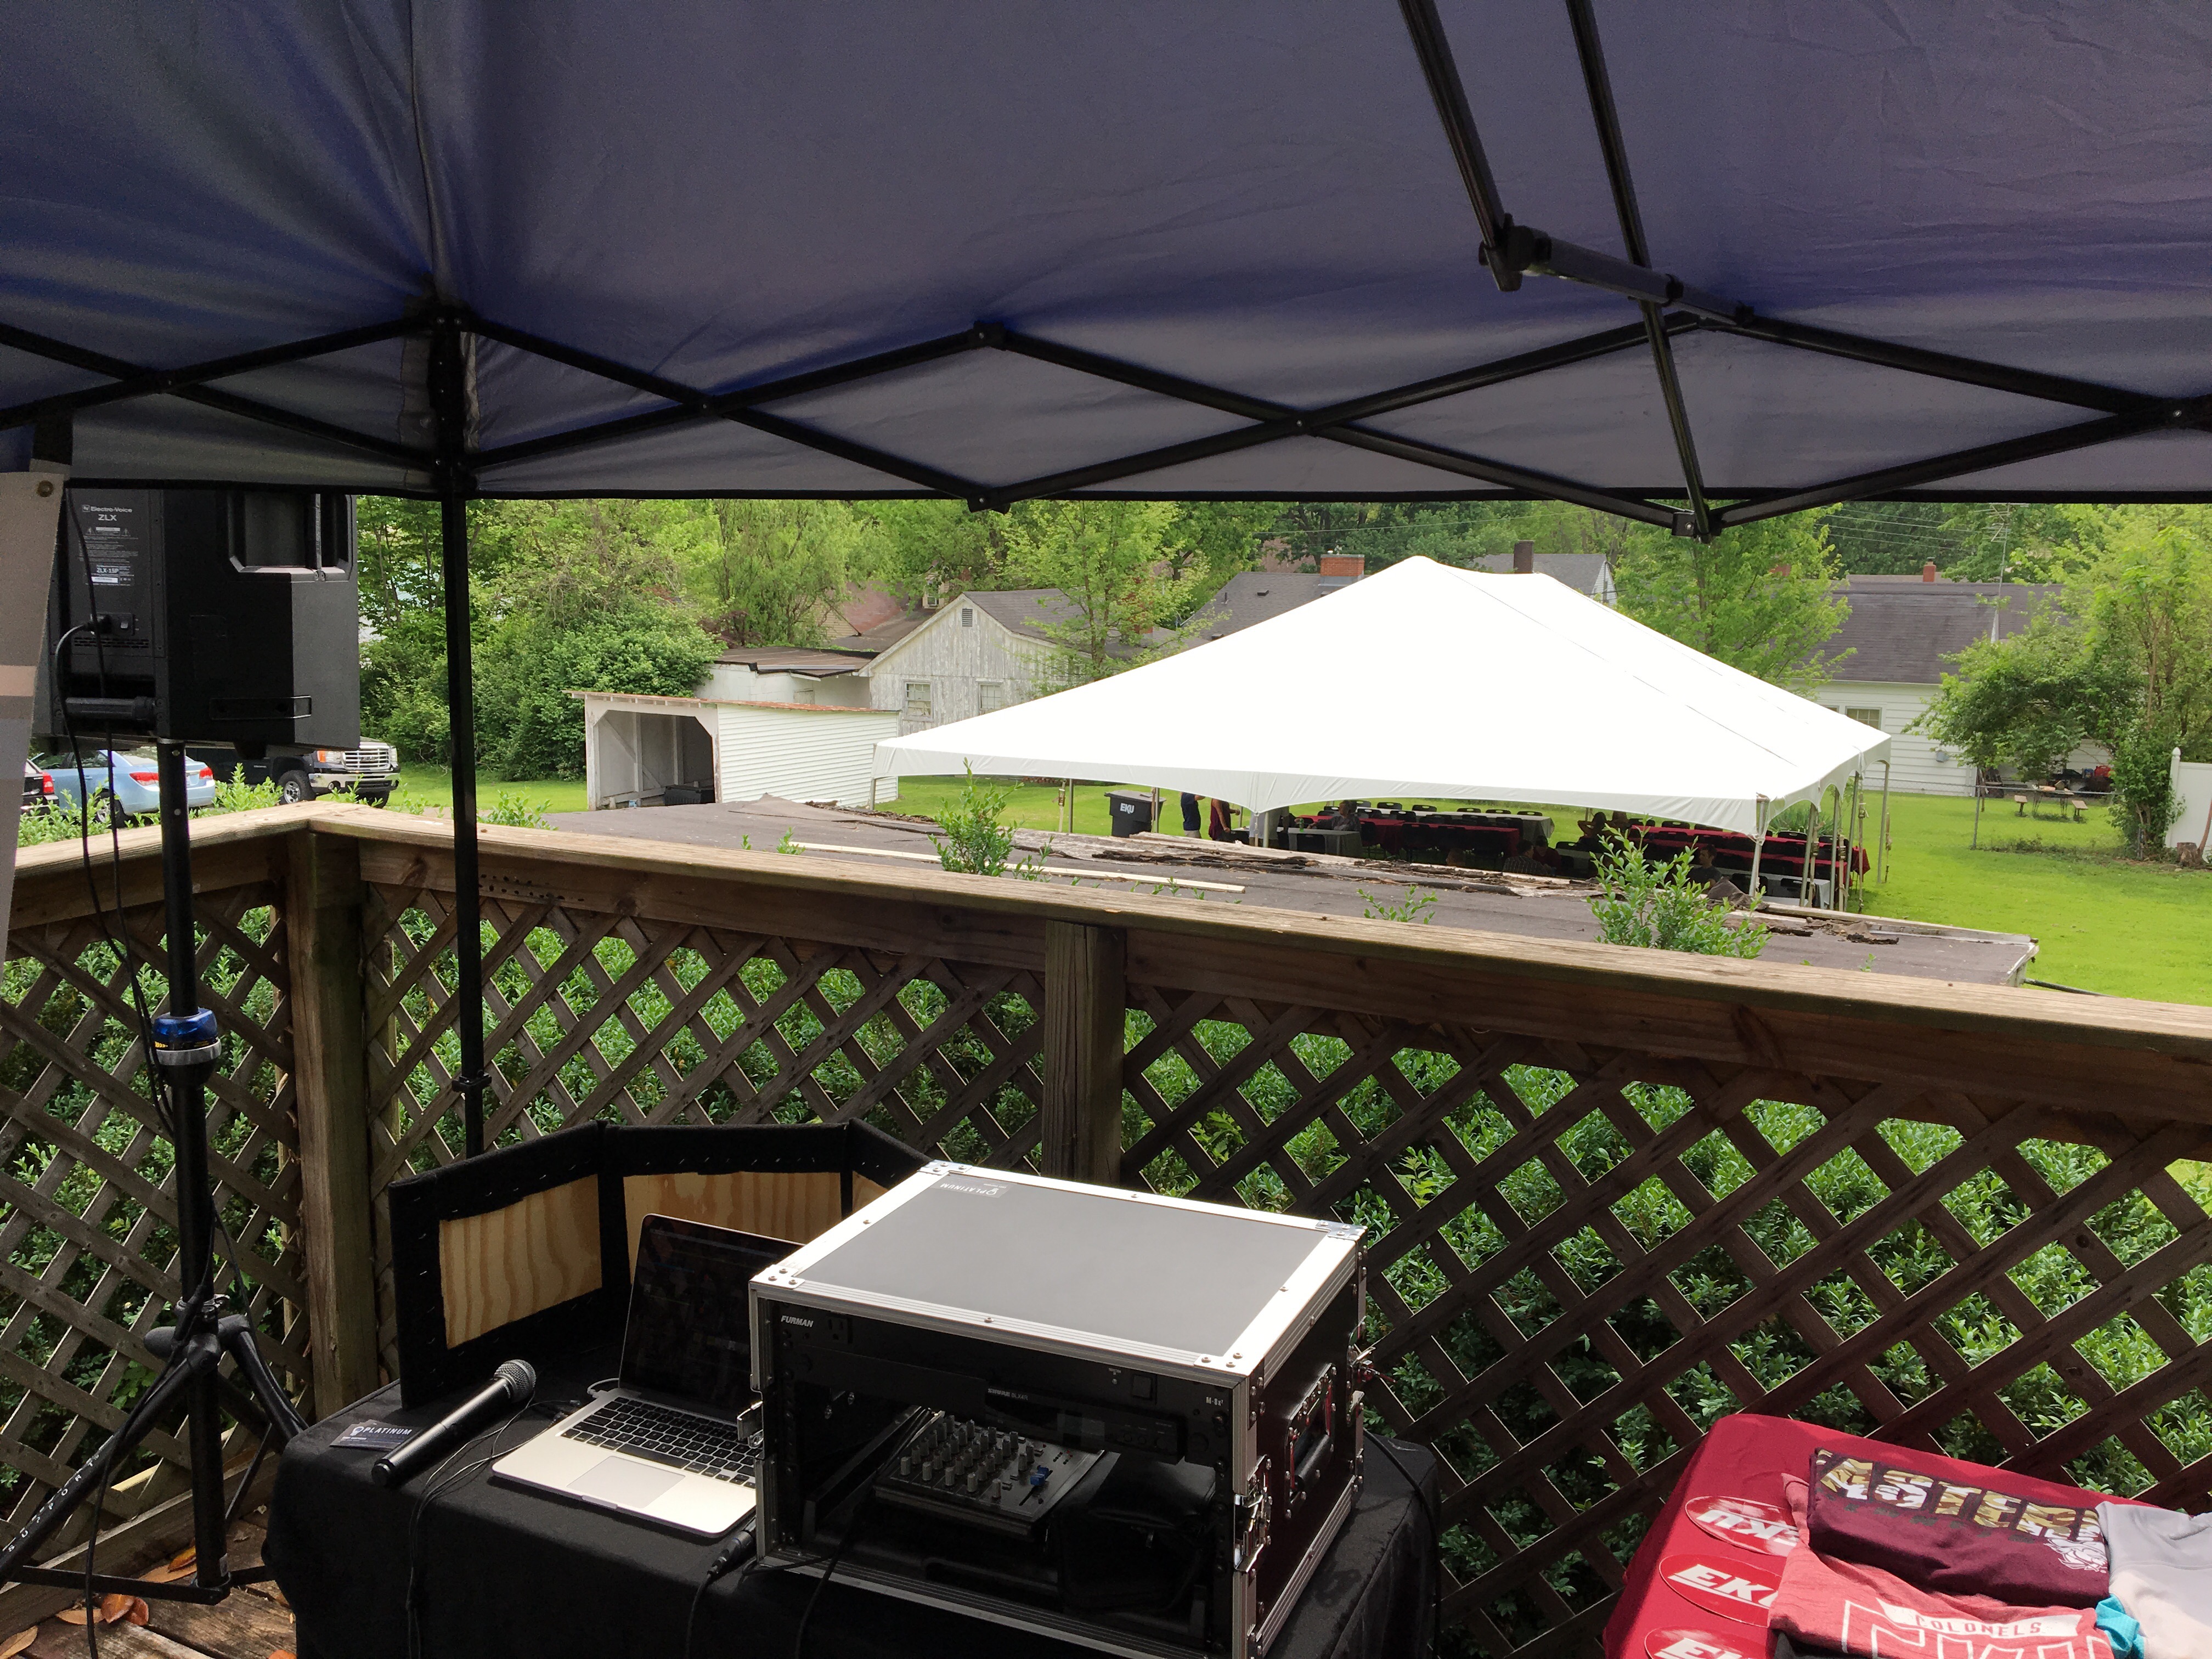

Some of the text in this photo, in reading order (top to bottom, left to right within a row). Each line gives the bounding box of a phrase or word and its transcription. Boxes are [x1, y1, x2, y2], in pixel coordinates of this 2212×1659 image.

[1120, 803, 1135, 814] EKU
[940, 1183, 987, 1194] PLATINUM
[781, 1315, 814, 1328] FURMAN
[363, 1427, 412, 1435] PLATINUM
[1915, 1614, 2042, 1637] COLONELS
